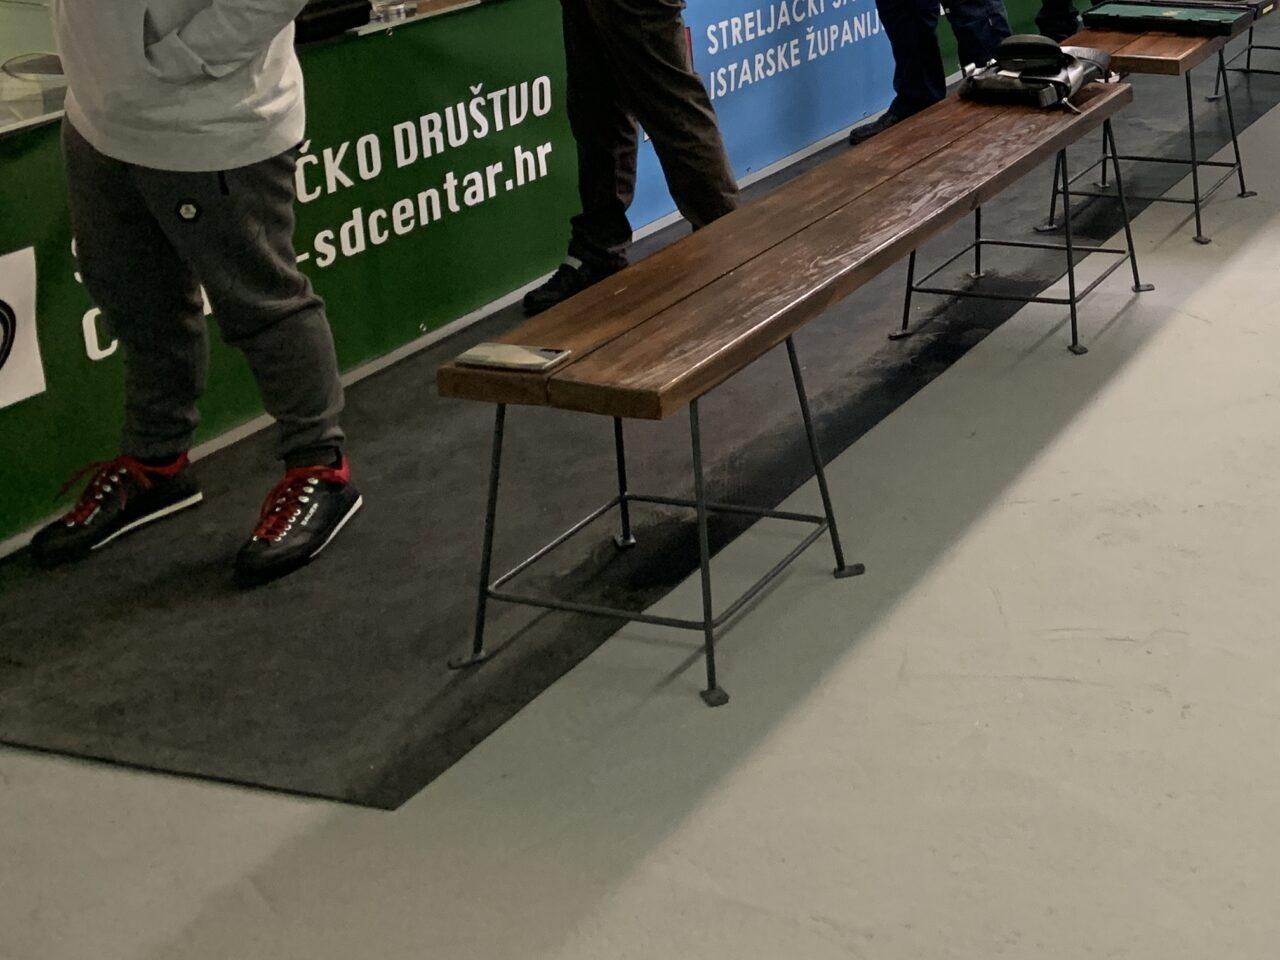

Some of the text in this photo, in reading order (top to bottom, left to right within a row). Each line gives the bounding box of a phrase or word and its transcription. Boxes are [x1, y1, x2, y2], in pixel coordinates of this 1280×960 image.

[709, 8, 885, 101] ISTARSKE ŽUPANIJ
[294, 75, 552, 204] ČKO DRUŠTVO
